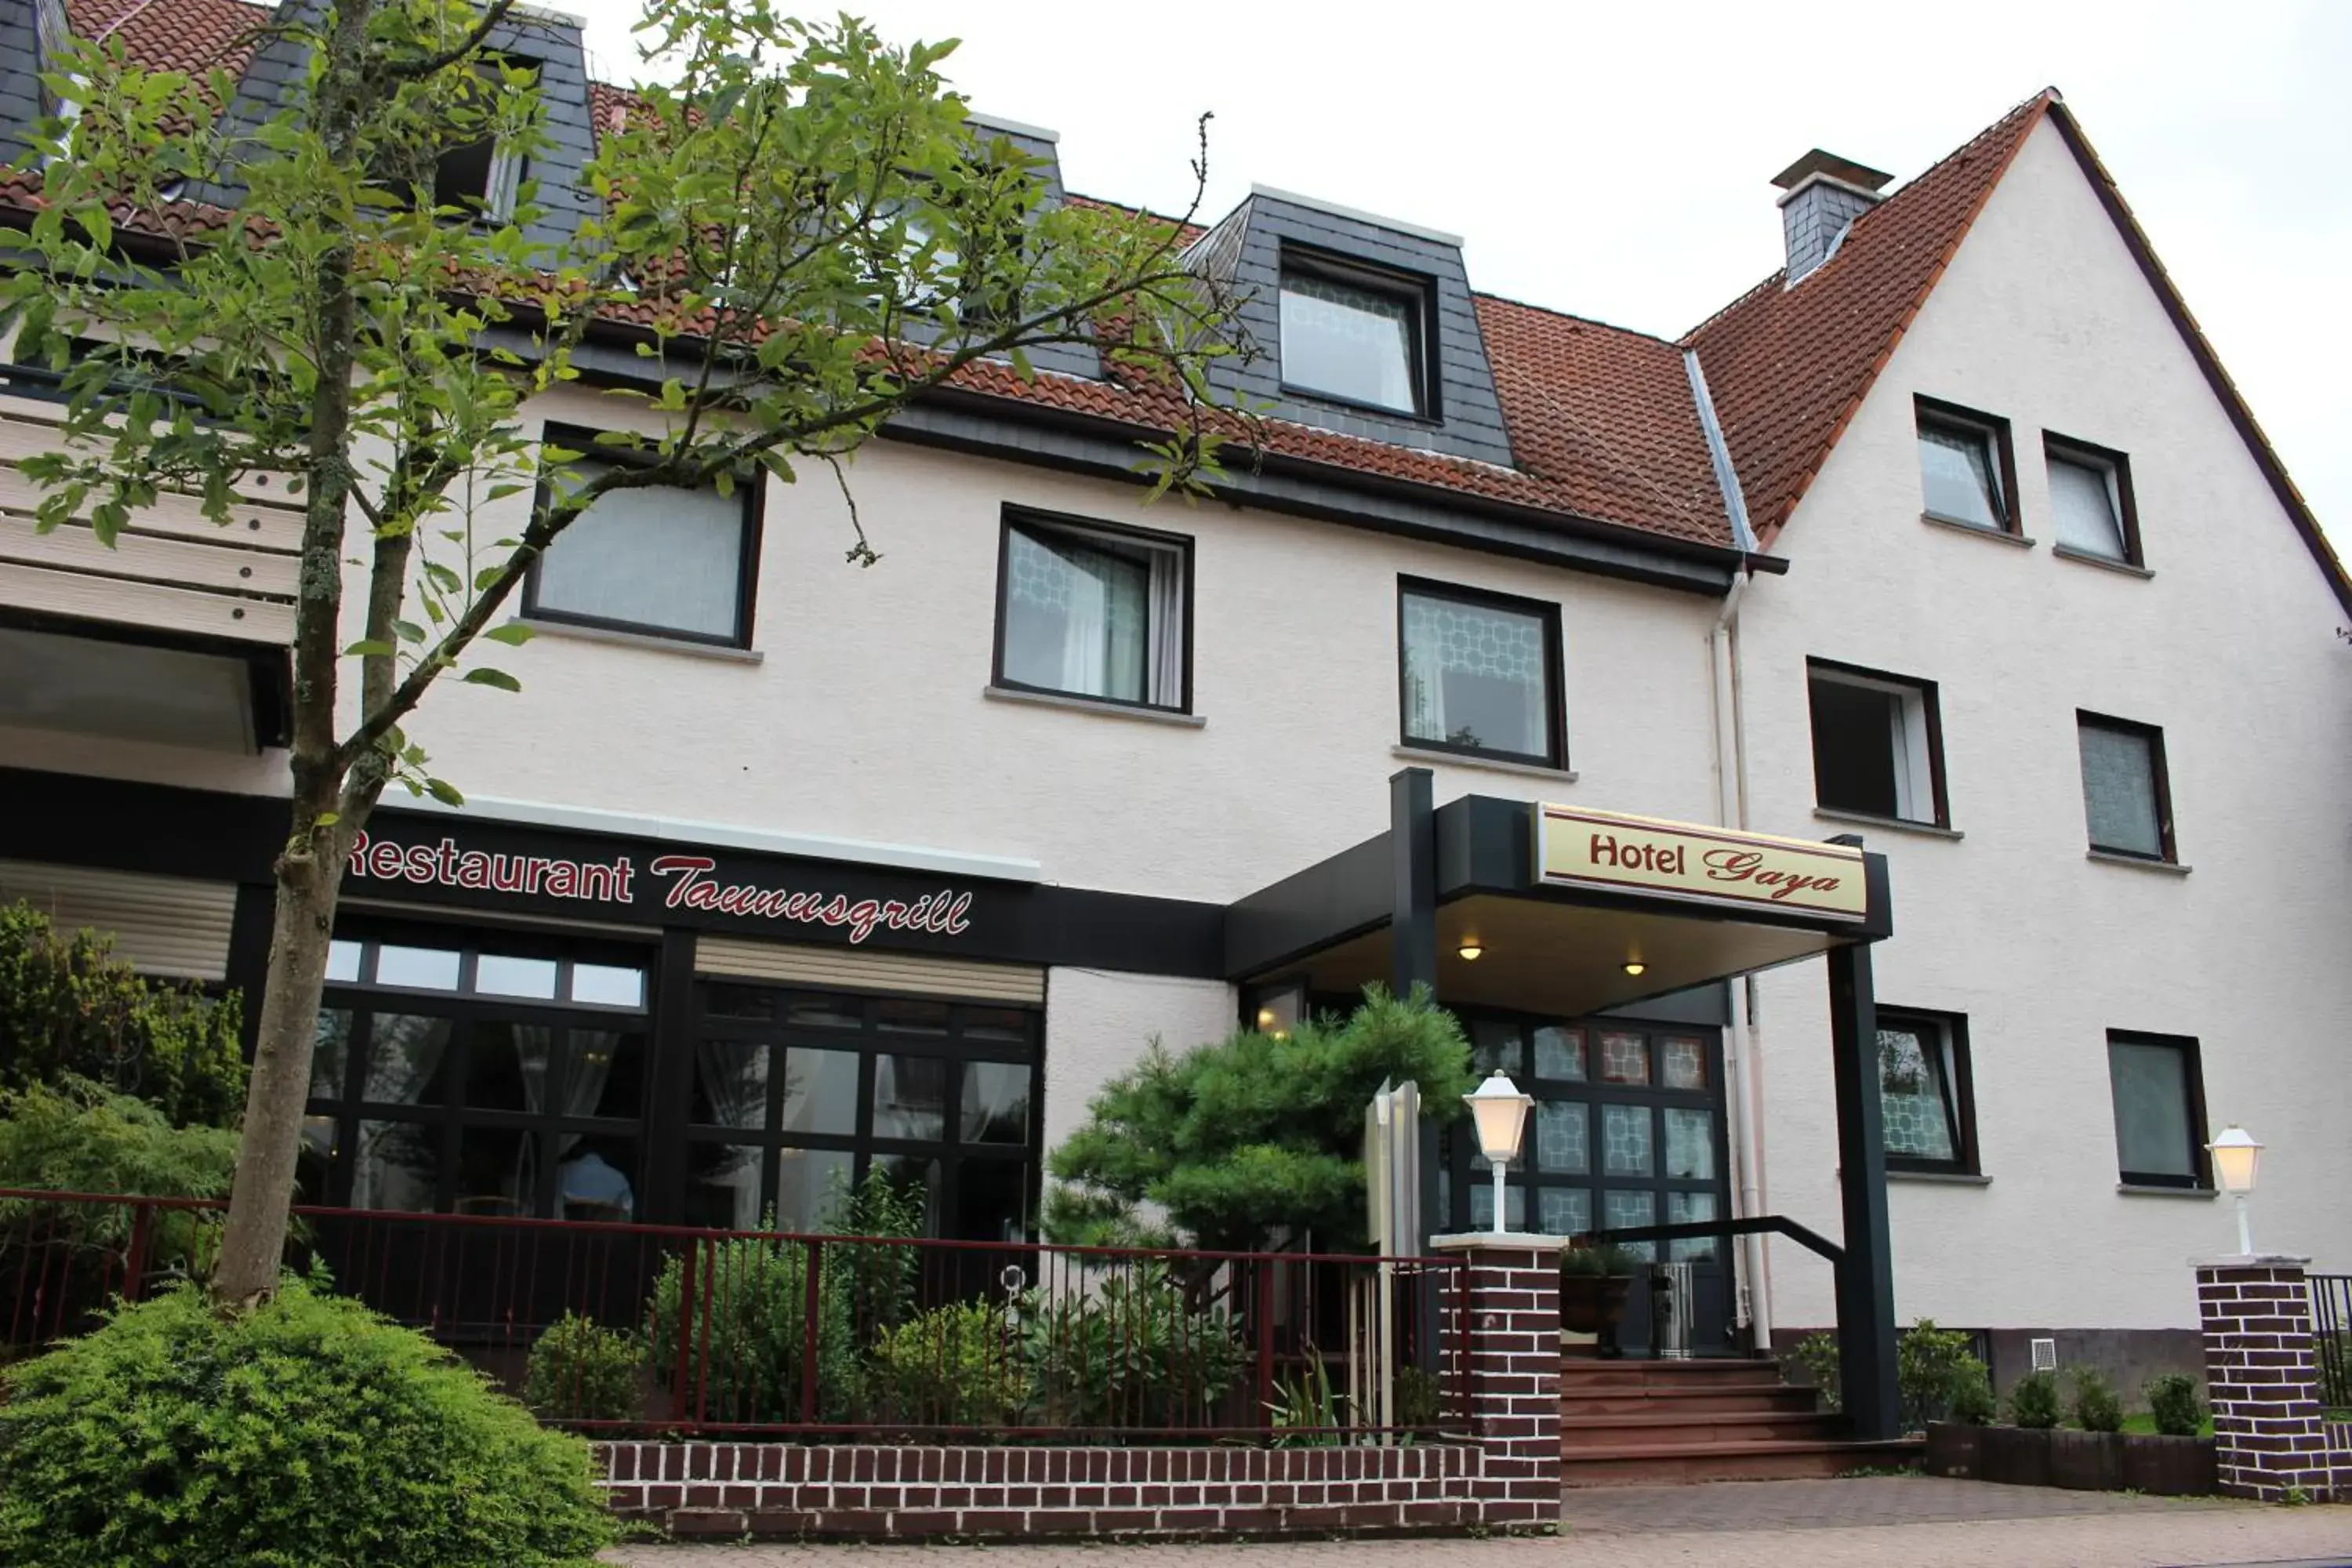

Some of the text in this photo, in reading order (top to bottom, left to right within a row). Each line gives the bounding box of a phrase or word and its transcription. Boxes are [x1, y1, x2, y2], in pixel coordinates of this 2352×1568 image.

[650, 855, 972, 943] Taunusgrill
[1590, 834, 1840, 898] Hotel Gaya
